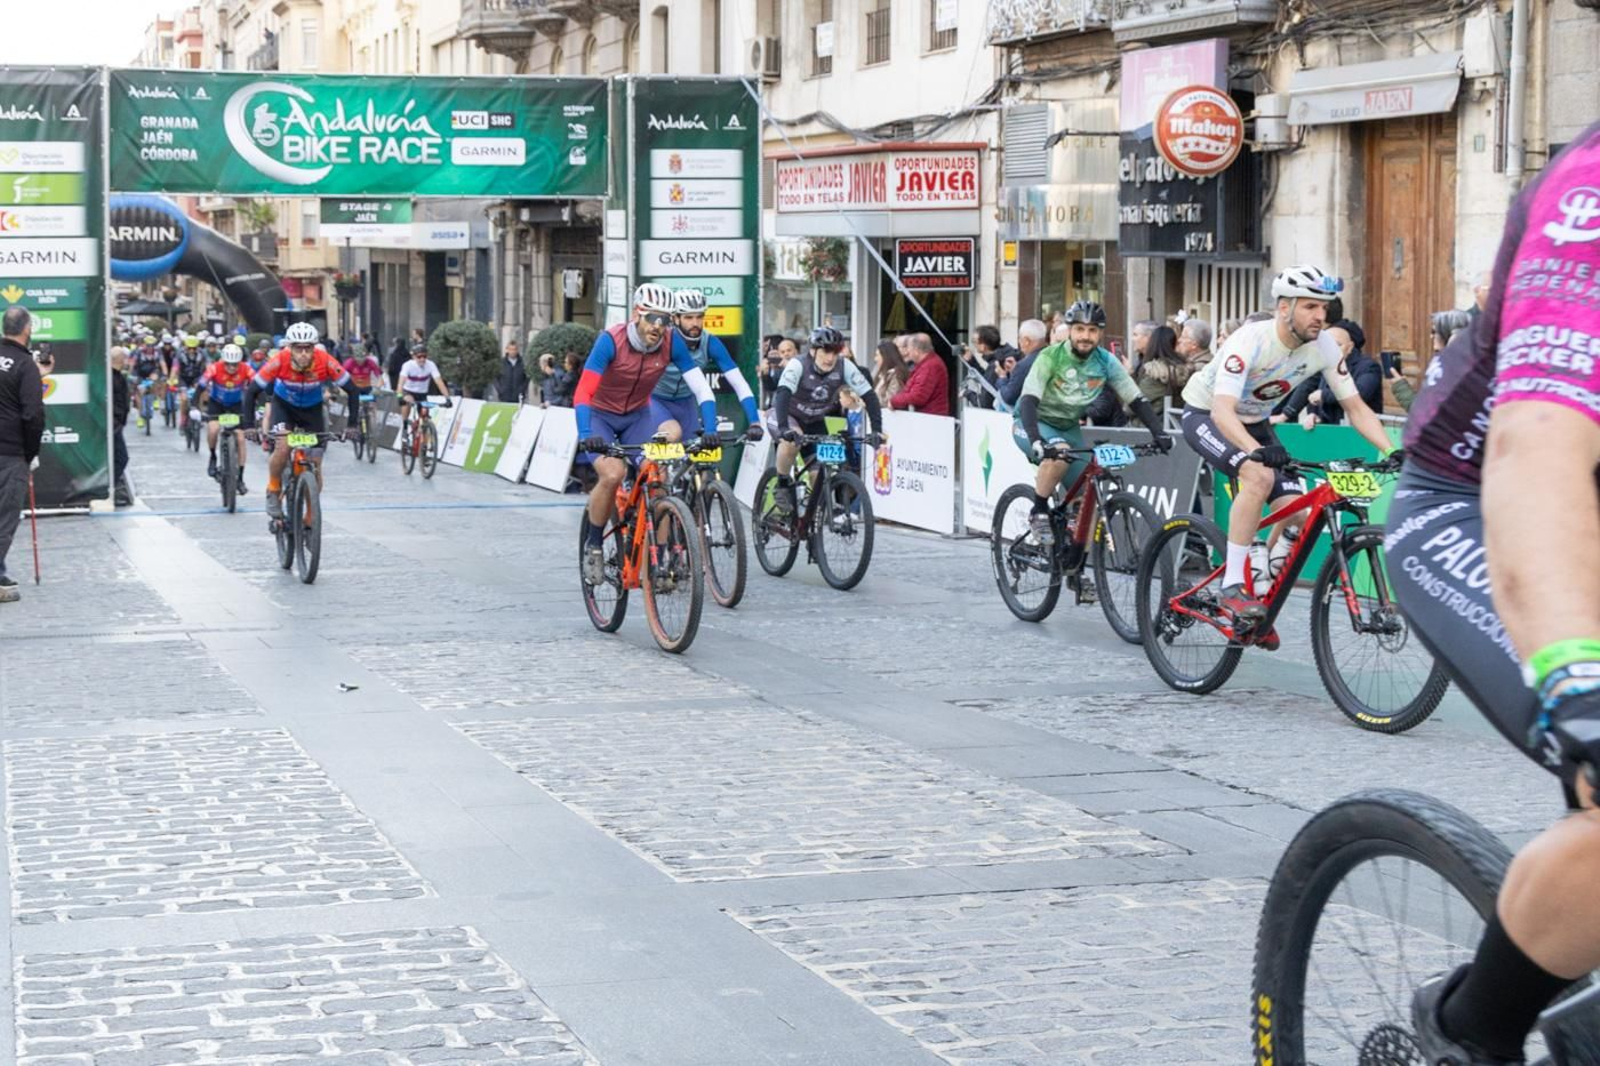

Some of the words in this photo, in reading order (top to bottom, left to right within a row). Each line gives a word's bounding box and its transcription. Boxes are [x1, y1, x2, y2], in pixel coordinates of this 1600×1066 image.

[140, 116, 199, 129] GRANADA
[281, 97, 441, 137] Andalucía
[458, 114, 485, 126] UCI
[647, 113, 710, 130] Andalucía
[1169, 118, 1236, 137] Mahou
[140, 131, 173, 145] JAÉN
[140, 146, 199, 161] CÓRDOBA
[283, 135, 351, 163] BIKE
[360, 136, 442, 165] RACE
[460, 146, 517, 156] GARMIN
[895, 157, 976, 170] OPORTUNIDADES
[779, 164, 843, 190] OPORTUNIDADES
[848, 162, 887, 203] JAVIER
[896, 171, 975, 191] JAVIER
[780, 193, 802, 204] TODO
[804, 193, 815, 204] EN
[818, 192, 844, 202] TELAS
[896, 193, 924, 201] TODO
[927, 193, 940, 201] EN
[944, 192, 976, 201] TELAS
[339, 202, 380, 211] STAGE
[108, 226, 175, 242] ARMIN
[900, 242, 971, 253] OPORTUNIDADES
[1185, 232, 1213, 252] 1974
[658, 251, 736, 265] GARMIN
[904, 256, 966, 272] JAVIER
[903, 277, 927, 286] TODO
[929, 277, 942, 286] EN
[944, 277, 969, 285] TELAS
[818, 446, 844, 459] 412-2
[1099, 447, 1132, 461] 412-1
[896, 458, 949, 479] AYUNTAMIENTO
[895, 476, 905, 489] DE
[1332, 474, 1377, 491] 329-2
